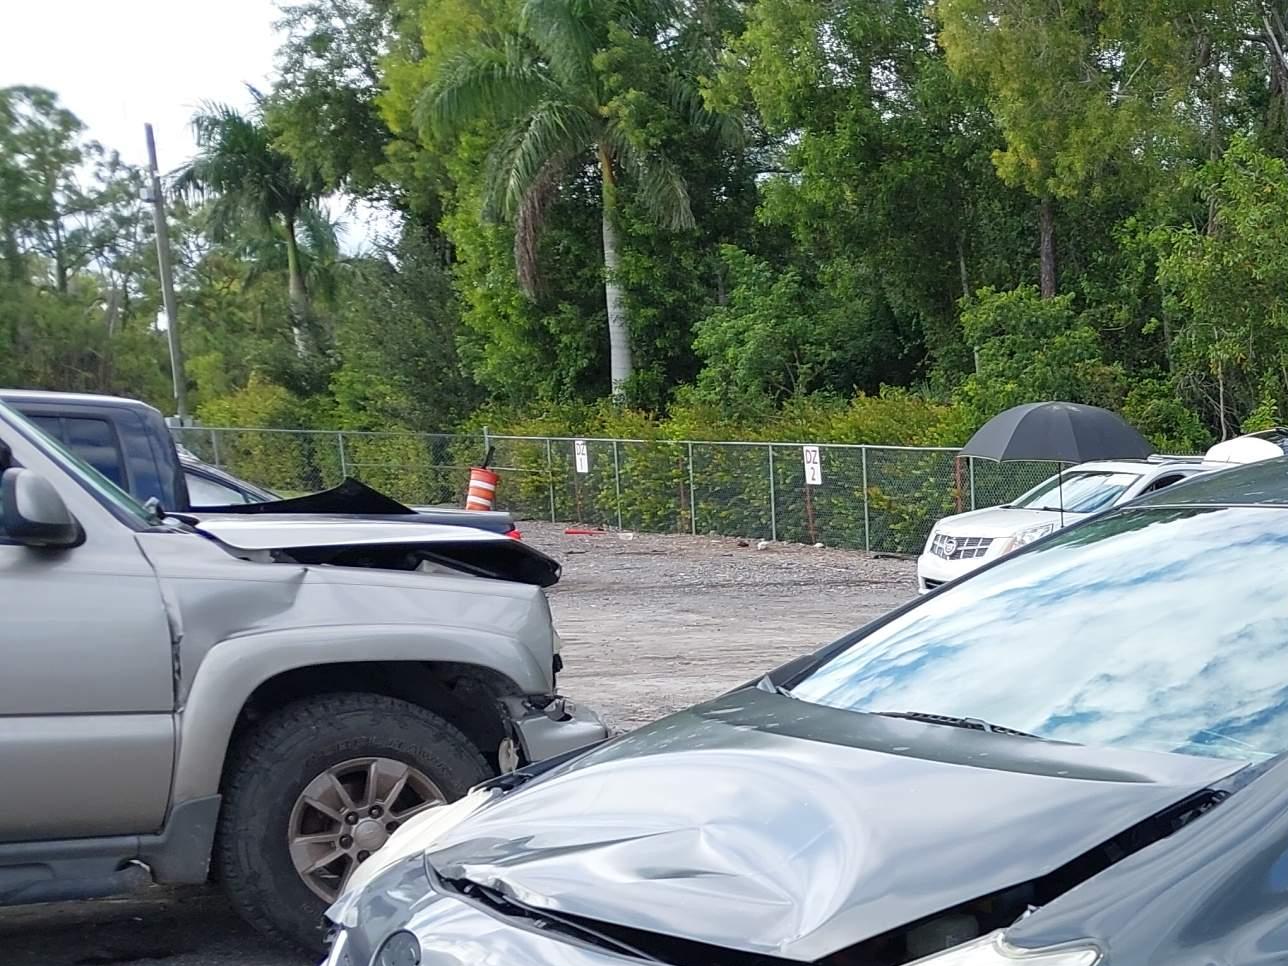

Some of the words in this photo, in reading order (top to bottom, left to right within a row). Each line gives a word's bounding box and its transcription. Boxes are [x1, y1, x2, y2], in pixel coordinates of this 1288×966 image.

[575, 442, 586, 456] DZ
[805, 449, 818, 465] DZ
[810, 466, 816, 481] 2
